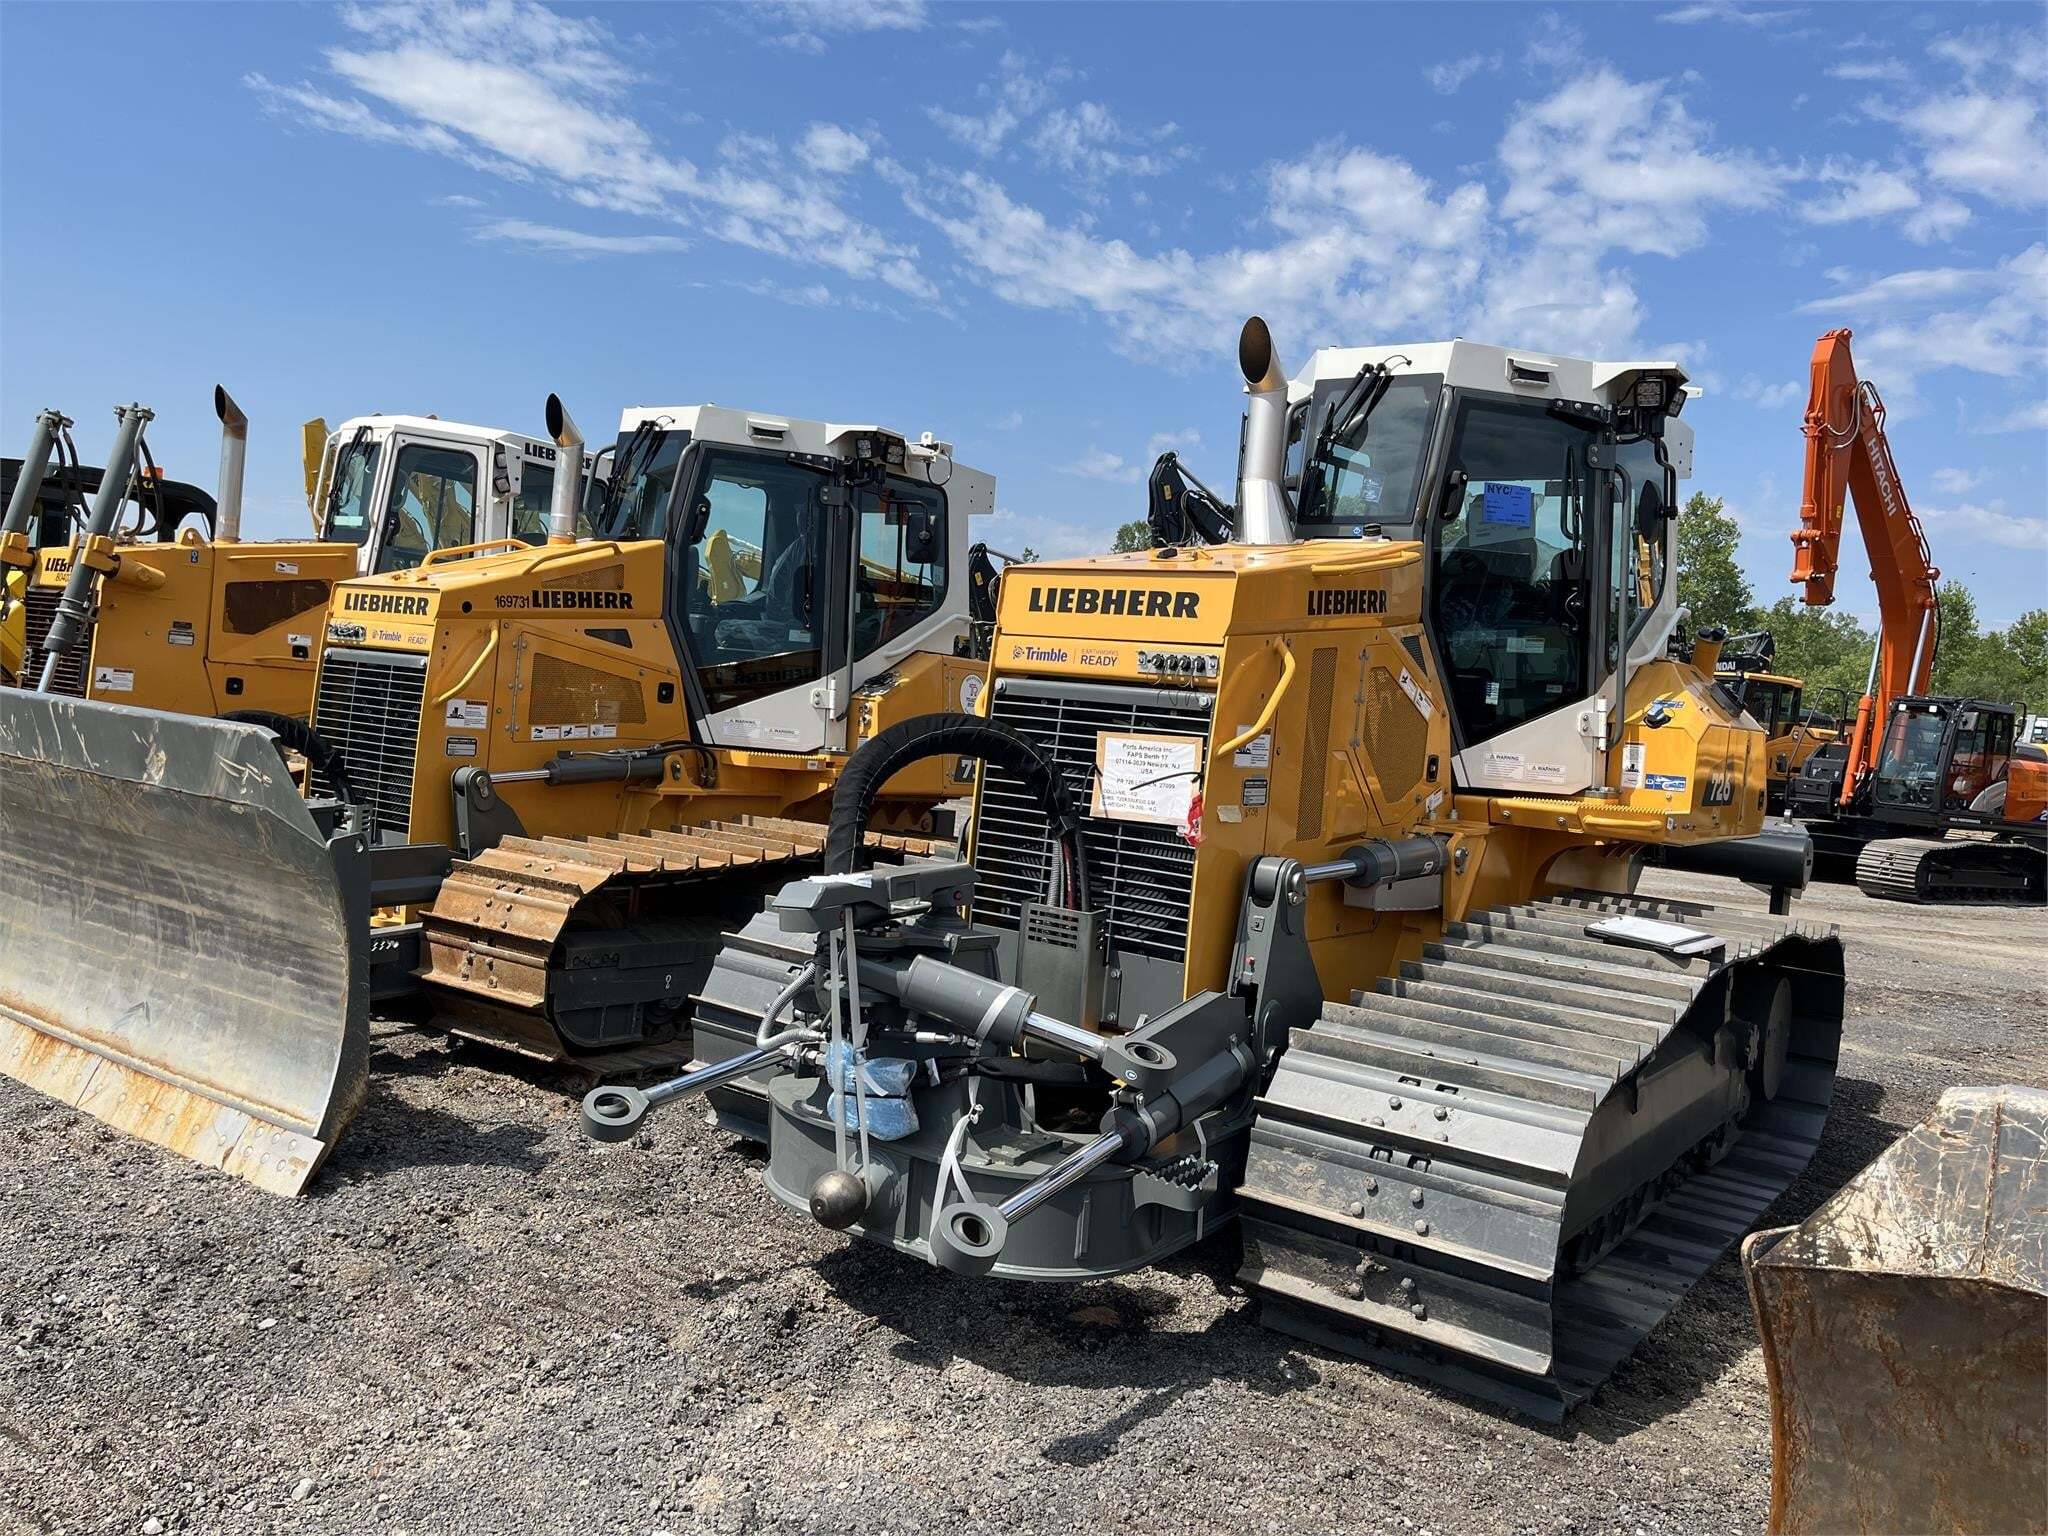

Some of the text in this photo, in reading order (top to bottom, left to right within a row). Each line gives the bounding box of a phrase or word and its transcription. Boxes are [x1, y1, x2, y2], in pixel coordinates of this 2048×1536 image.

[1868, 437, 1897, 517] HITACHI
[344, 592, 429, 616] LIEBHERR
[494, 589, 634, 609] 169731 LIEBHERR
[1028, 587, 1201, 620] LIEBHERR
[1307, 589, 1387, 616] LIEBHERR
[379, 630, 401, 642] Trimble
[1025, 646, 1068, 662] Trimble
[1080, 655, 1118, 667] READY
[1127, 751, 1142, 759] FAPS
[1711, 773, 1731, 801] 726
